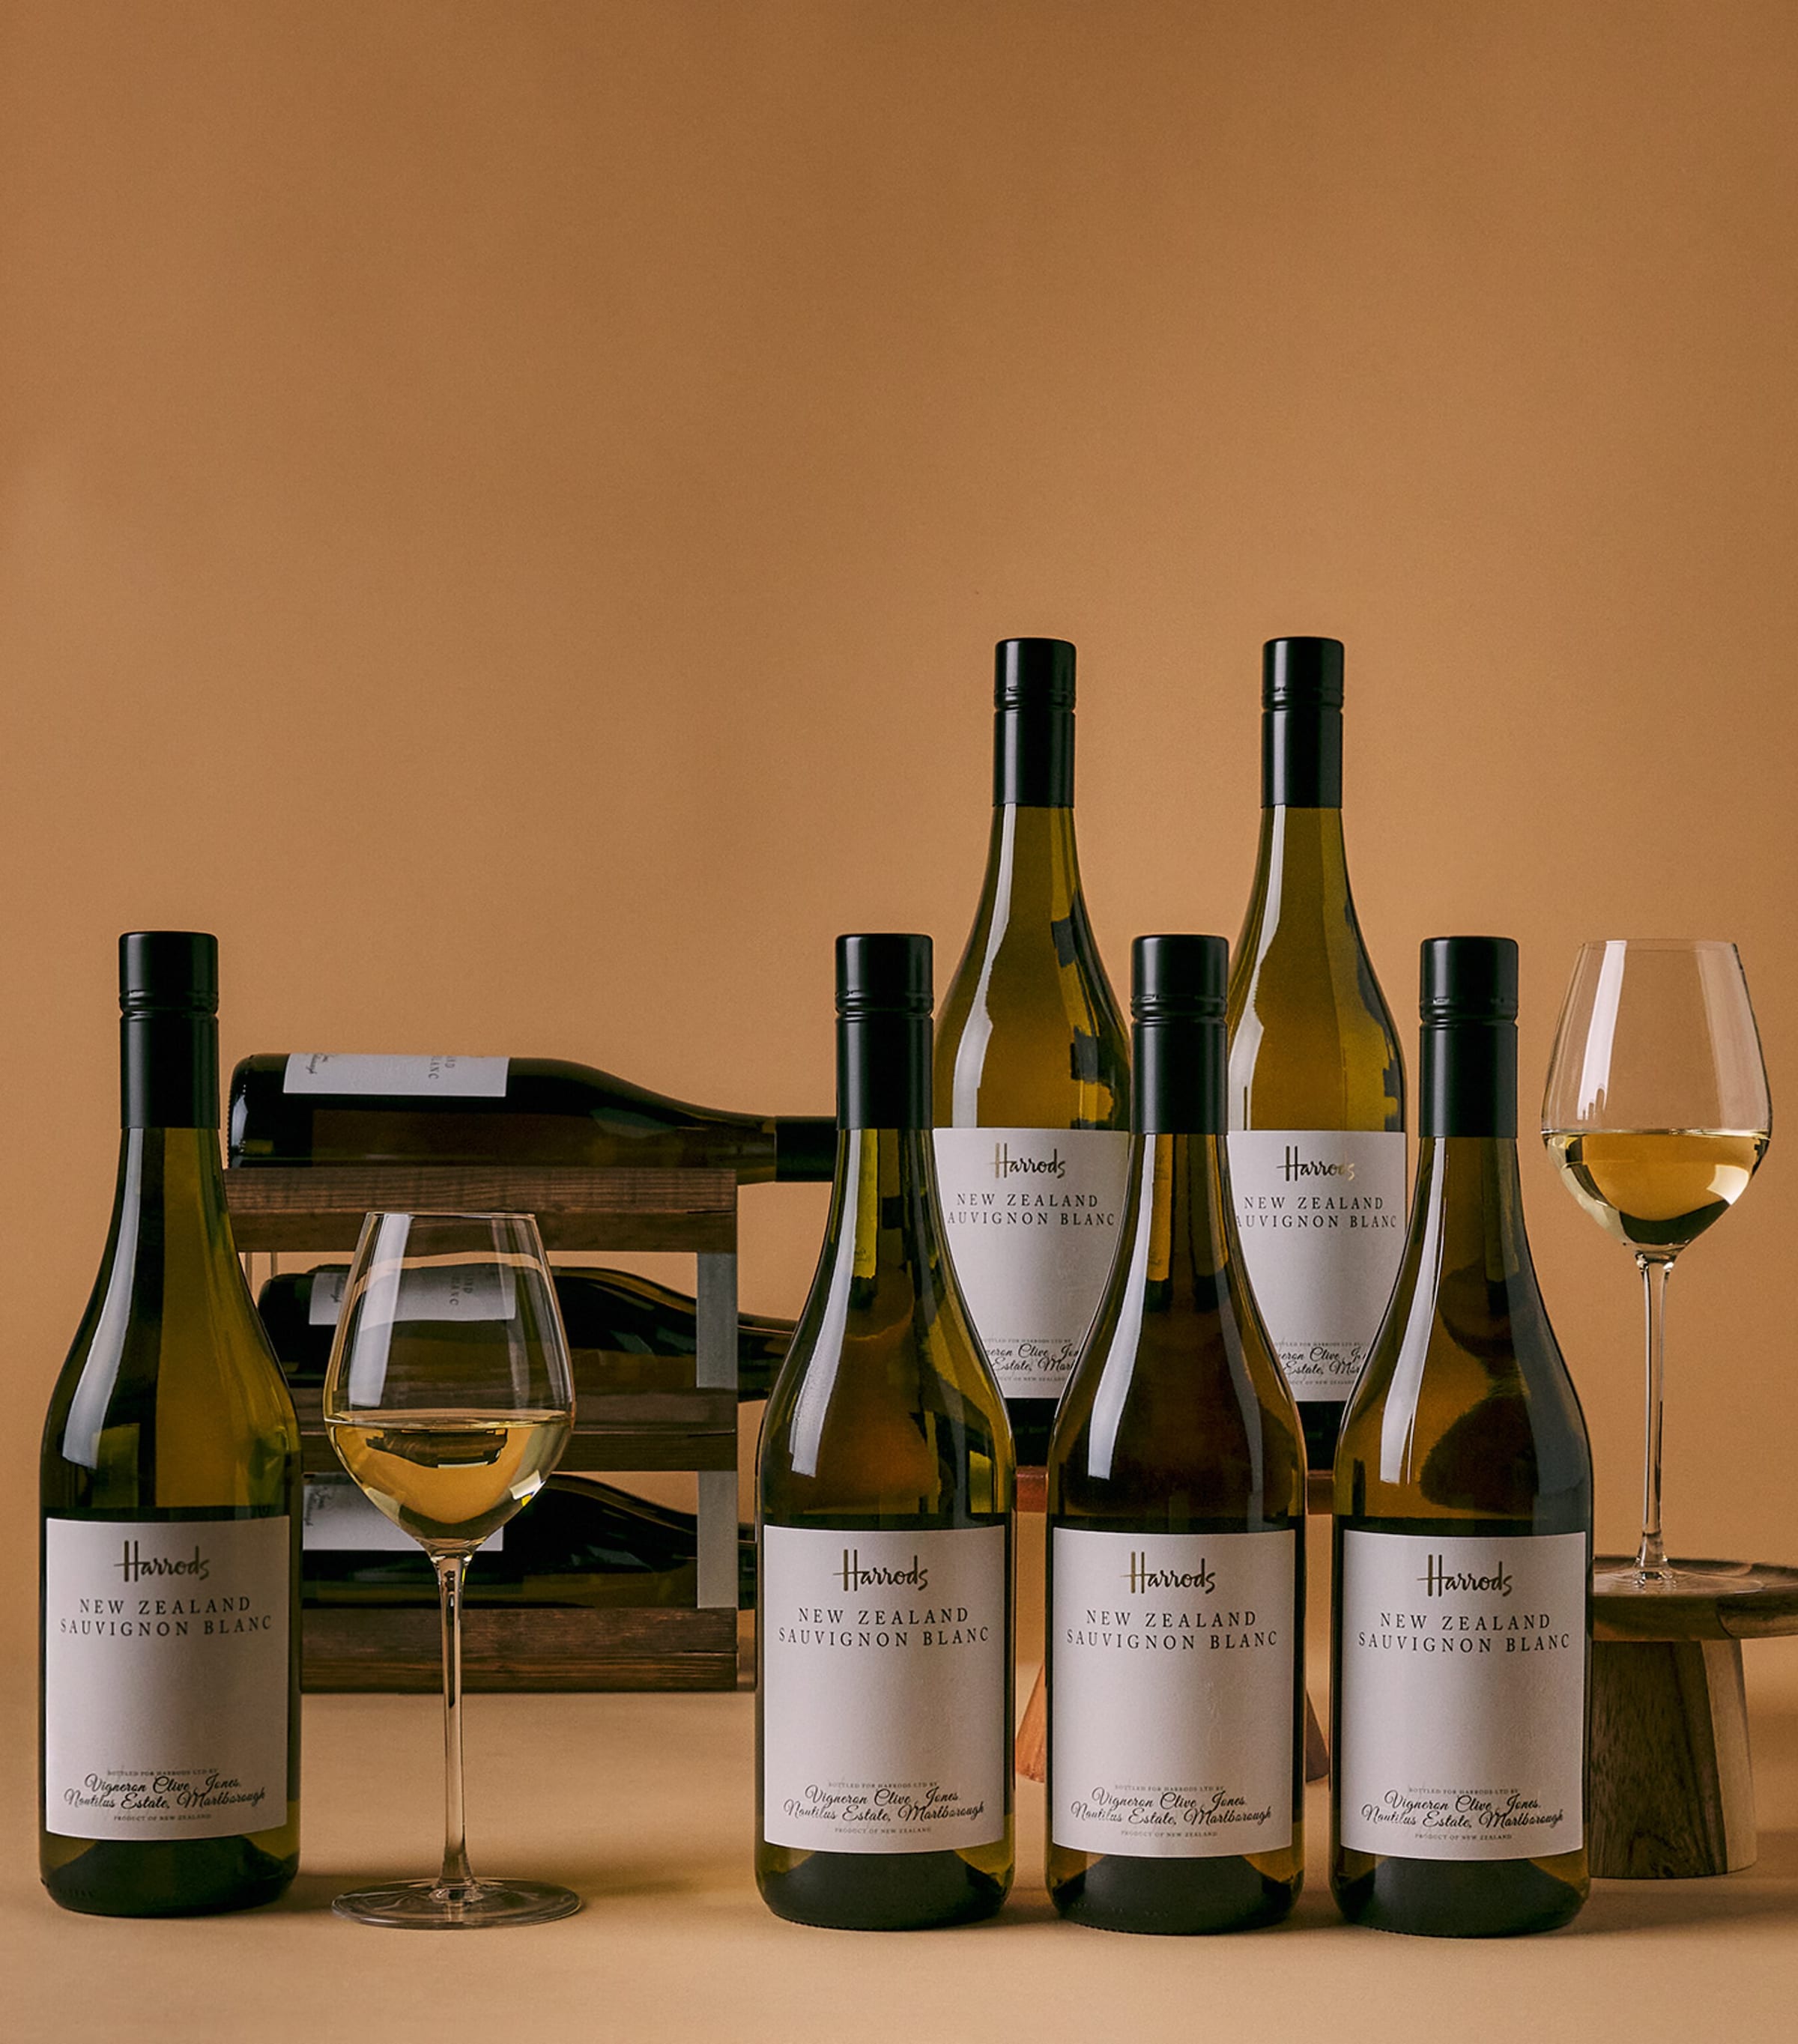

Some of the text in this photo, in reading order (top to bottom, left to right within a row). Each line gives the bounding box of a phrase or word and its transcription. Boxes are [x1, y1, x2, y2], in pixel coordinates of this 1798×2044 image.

[990, 1142, 1065, 1178] Harrods
[957, 1193, 1099, 1207] NEW ZEALAND
[1244, 1197, 1384, 1210] NEW ZEALAND
[947, 1211, 1116, 1226] AUVIGNON BLANC
[1236, 1215, 1397, 1228] AUVIGNON BLANC
[114, 1540, 210, 1582] Harrods
[832, 1549, 928, 1592] Harrods
[1119, 1551, 1216, 1594] Harrods
[1417, 1554, 1513, 1597] Harrods
[79, 1596, 251, 1615] NEW ZEALAND
[799, 1607, 969, 1625] NEW ZEALAND
[60, 1615, 272, 1637] SAUVIGNON BLANC
[1086, 1609, 1257, 1628] NEW ZEALAND
[1379, 1612, 1551, 1631] NEW ZEALAND
[778, 1626, 990, 1647] SAUVIGNON BLANC
[1066, 1628, 1278, 1649] SAUVIGNON BLANC
[1358, 1632, 1570, 1653] SAUVIGNON BLANC
[85, 1773, 146, 1797] Vigneron
[152, 1775, 189, 1794] Clive
[805, 1784, 868, 1808] Vigneron
[874, 1788, 911, 1807] Clive
[64, 1789, 115, 1808] Nautilus
[176, 1787, 265, 1808] Marlborough
[1091, 1786, 1154, 1811] Vigneron
[1160, 1792, 1196, 1810] Clive
[1384, 1789, 1449, 1814] Vigneron
[1455, 1794, 1492, 1813] Clive
[783, 1799, 836, 1819] Nautilus
[898, 1801, 984, 1822] Marlborough
[1071, 1801, 1122, 1822] Nautilus
[1183, 1806, 1271, 1825] Marlborough
[1361, 1804, 1417, 1826] Nautilus
[1479, 1809, 1564, 1829] Marlborough
